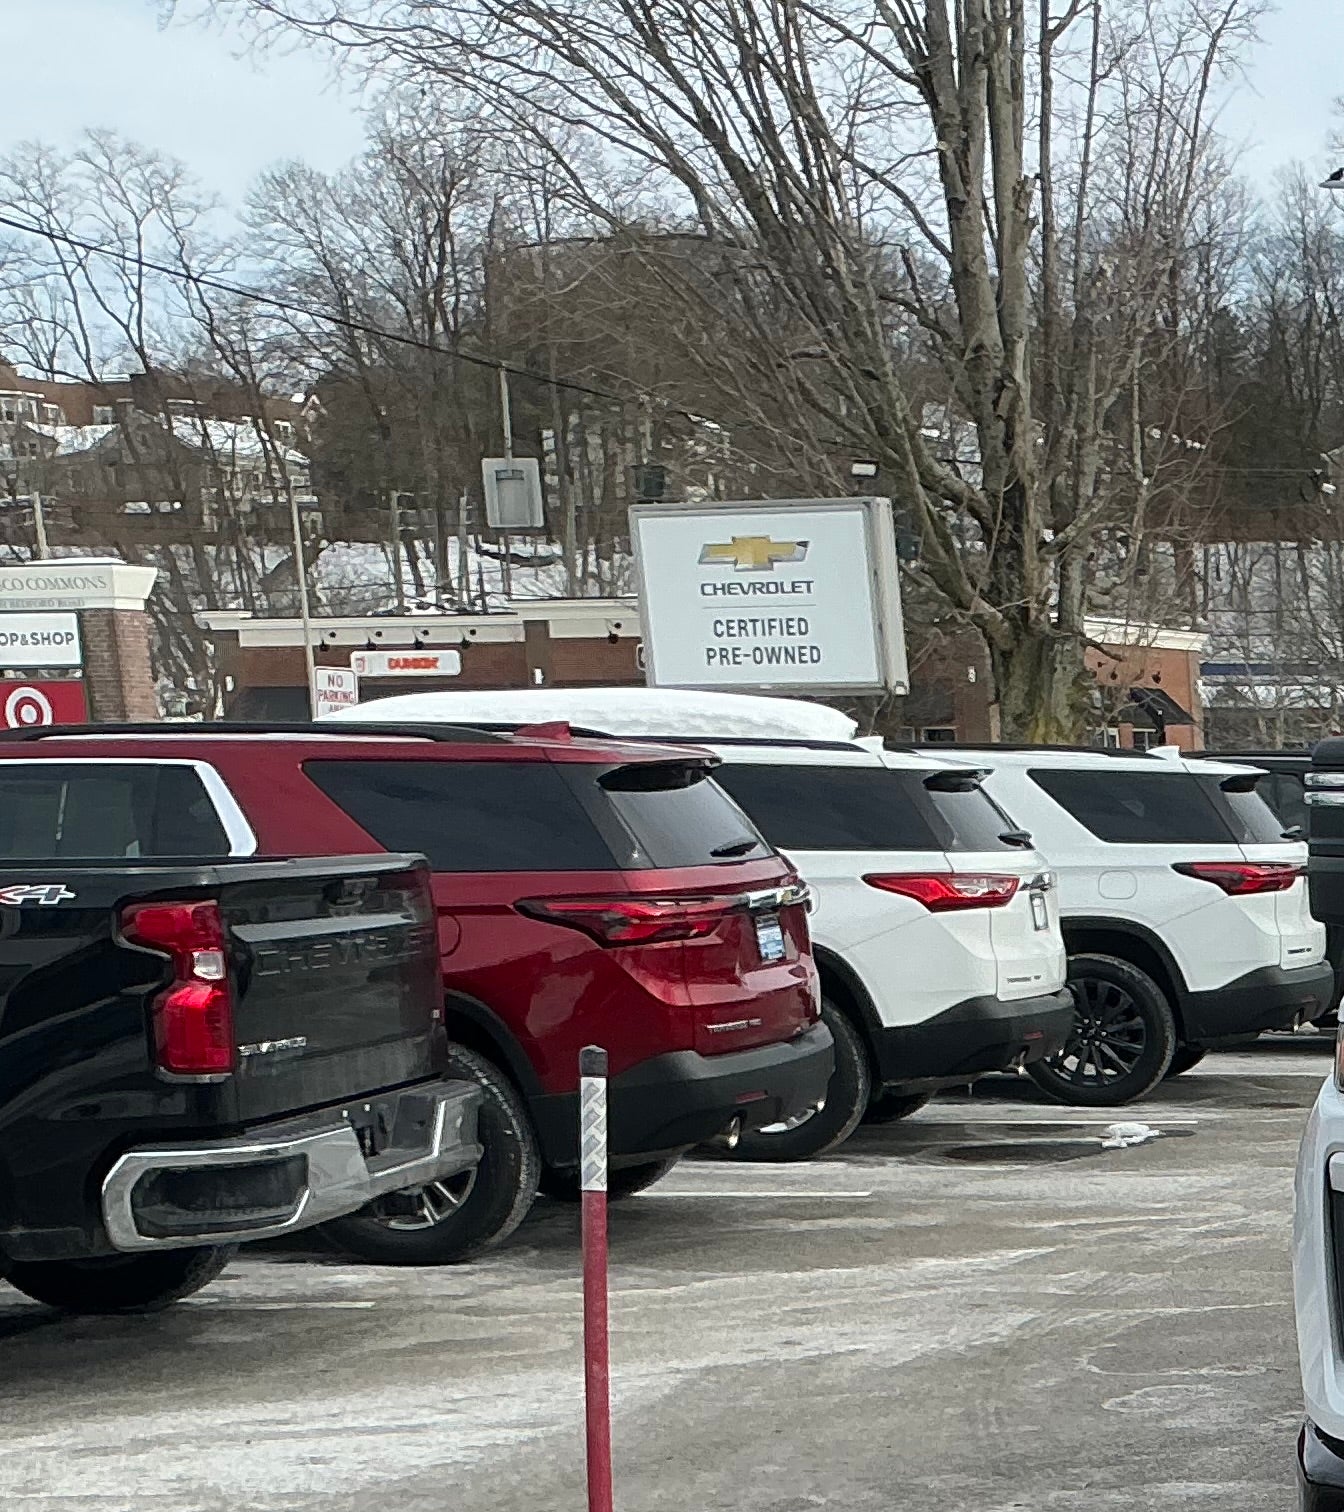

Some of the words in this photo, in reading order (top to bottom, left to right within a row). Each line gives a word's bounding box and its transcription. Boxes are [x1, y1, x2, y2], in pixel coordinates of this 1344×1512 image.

[26, 575, 107, 591] COMMONS
[700, 580, 814, 596] CHEVROLET
[713, 617, 809, 638] CERTIFIED
[706, 645, 821, 666] PRE-OWNED
[327, 673, 344, 689] NO
[318, 690, 354, 704] PARKING
